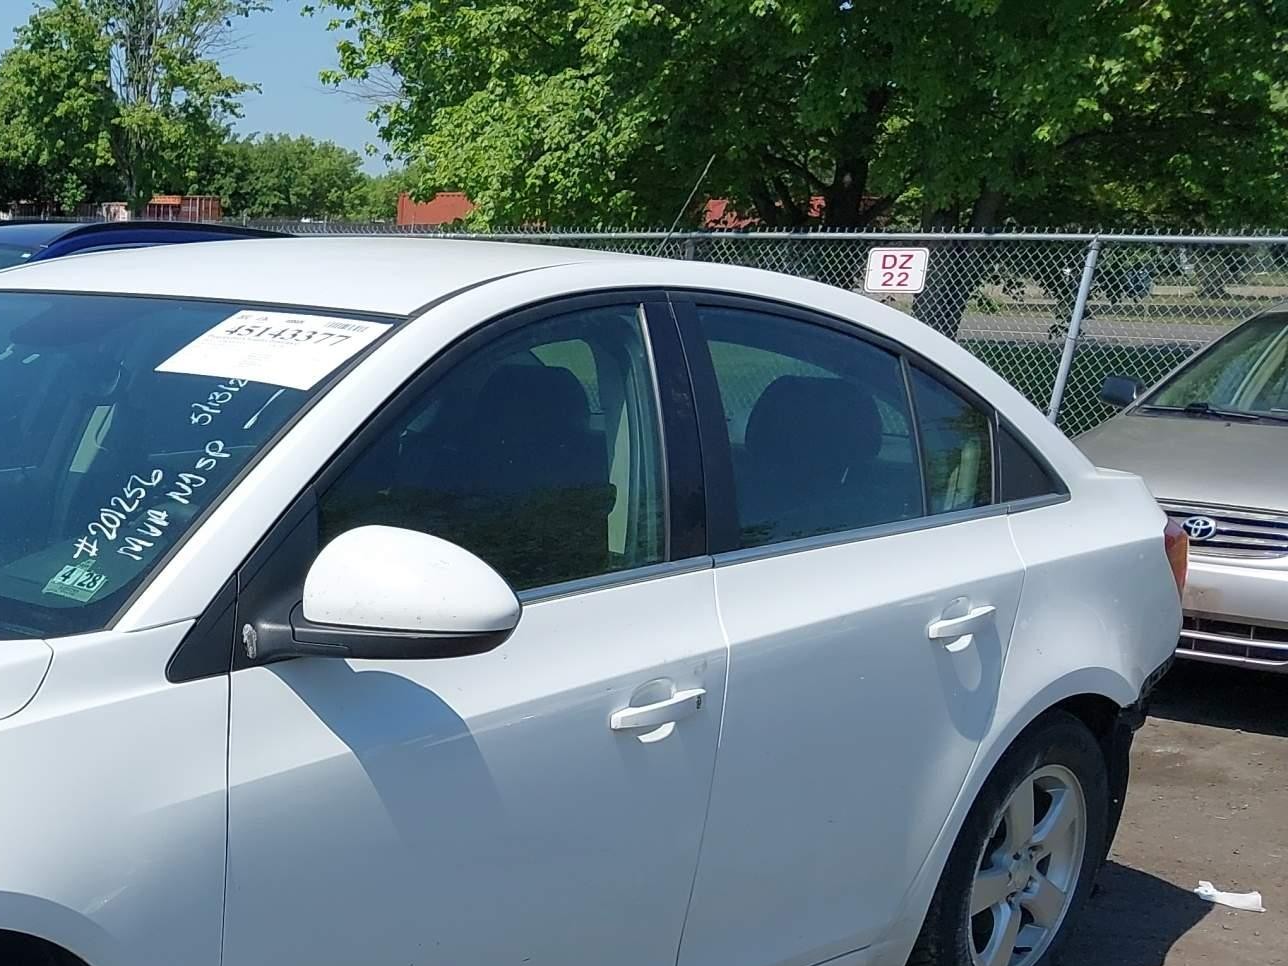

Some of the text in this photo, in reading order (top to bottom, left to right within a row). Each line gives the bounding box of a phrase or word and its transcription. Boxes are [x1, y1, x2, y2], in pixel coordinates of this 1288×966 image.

[882, 254, 914, 270] DZ
[881, 271, 910, 287] 22
[225, 325, 352, 346] 45143377
[117, 509, 170, 561] MVA
[61, 567, 77, 582] 4
[76, 572, 104, 589] 28
